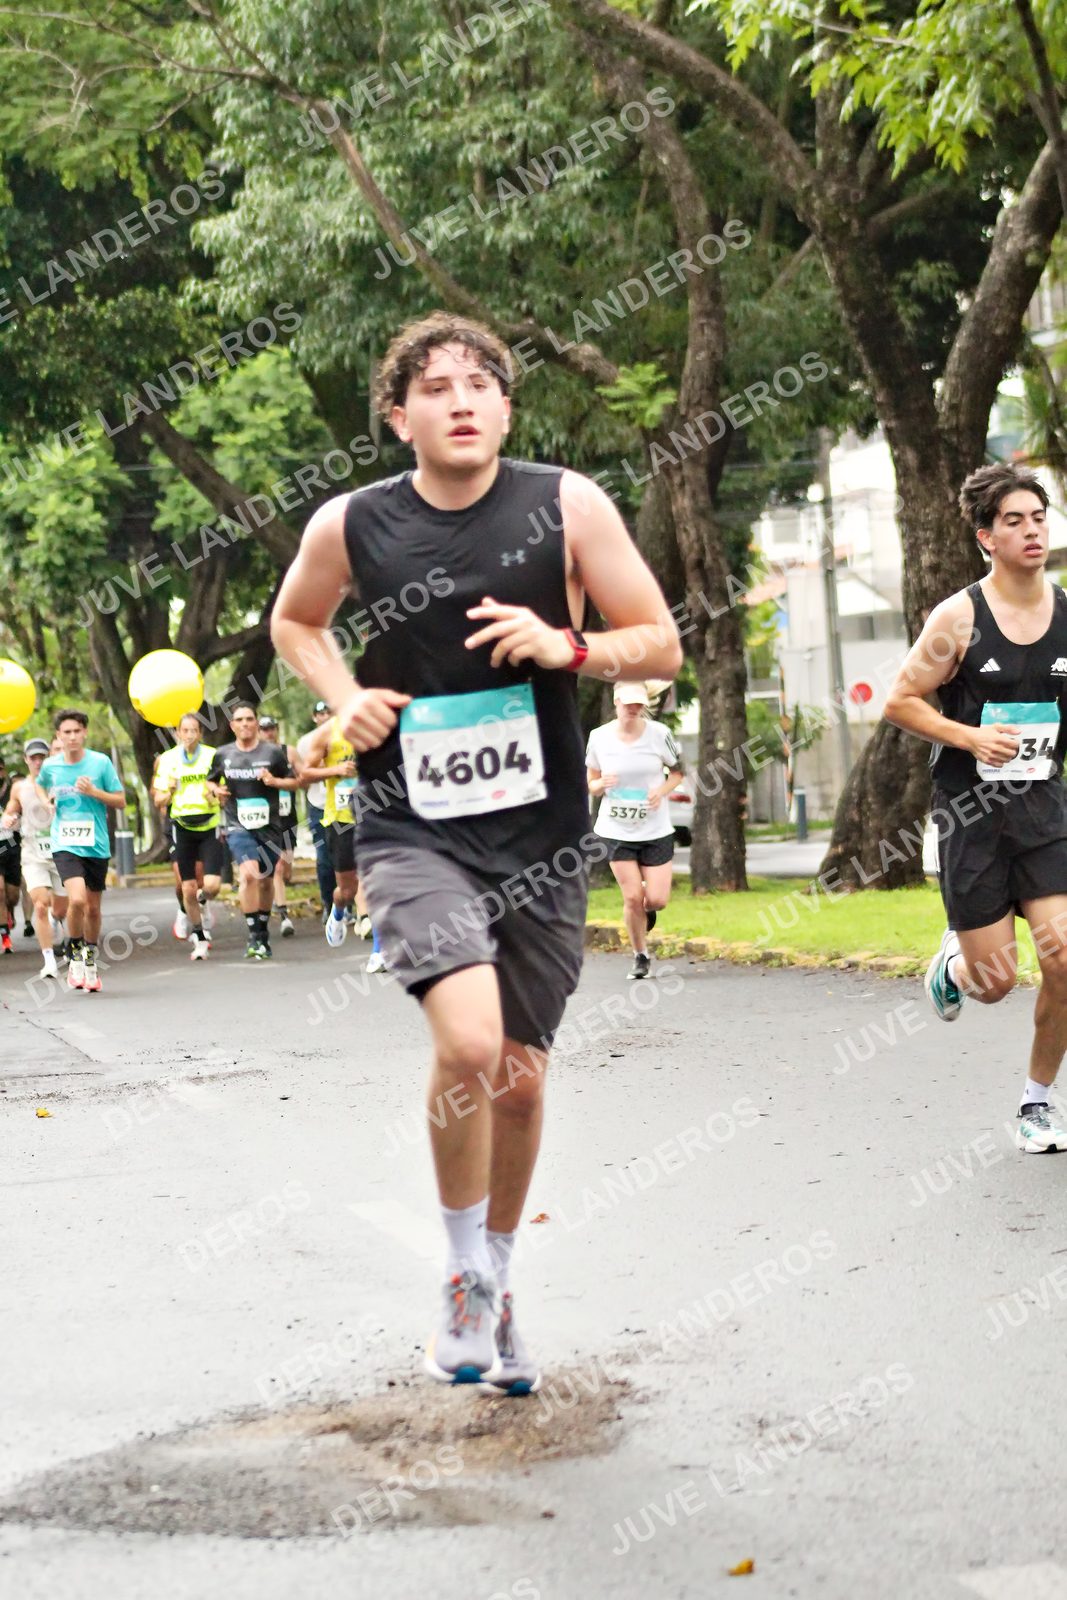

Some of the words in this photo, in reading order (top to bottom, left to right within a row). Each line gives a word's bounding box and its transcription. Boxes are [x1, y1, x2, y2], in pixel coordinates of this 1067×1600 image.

[1012, 737, 1056, 761] 34
[418, 741, 532, 787] 4604
[240, 812, 267, 822] 5674
[609, 805, 647, 819] 5376
[61, 827, 92, 837] 5577
